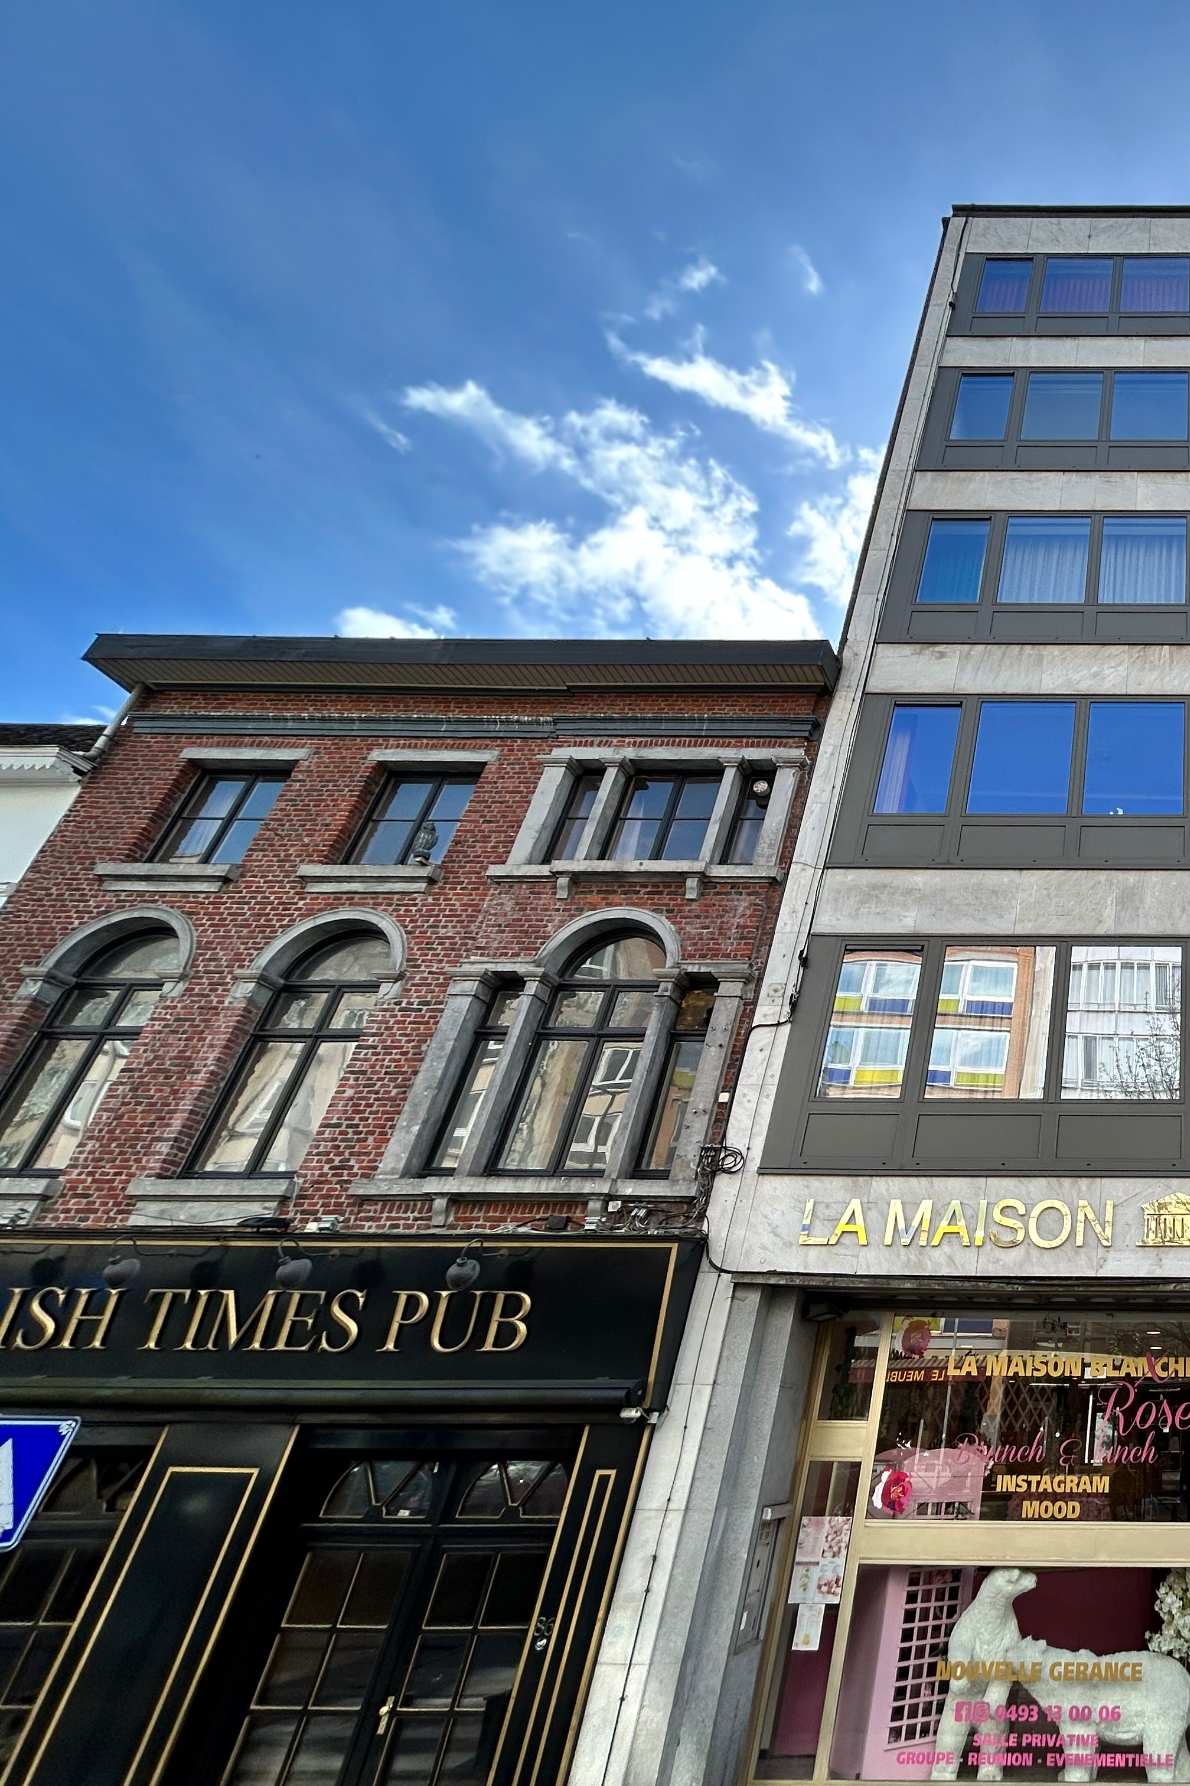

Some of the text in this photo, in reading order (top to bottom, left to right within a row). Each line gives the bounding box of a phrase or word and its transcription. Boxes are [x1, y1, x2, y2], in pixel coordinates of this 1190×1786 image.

[799, 1198, 868, 1246] LA
[883, 1198, 1114, 1249] MAISON
[137, 1288, 367, 1352] TIMES
[376, 1290, 532, 1352] PUB
[947, 1355, 978, 1376] LA
[985, 1355, 1082, 1377] MAISON
[996, 1474, 1110, 1493] INSTAGRAM
[1021, 1500, 1081, 1519] MOOD
[1049, 1661, 1143, 1682] GERANCE
[994, 1704, 1039, 1722] 0493
[1067, 1704, 1092, 1722] 00
[1098, 1704, 1121, 1722] 06
[972, 1732, 1099, 1748] SALLE PRIVATIVE
[896, 1751, 954, 1766] GROUPE
[967, 1752, 1033, 1767] REUNION
